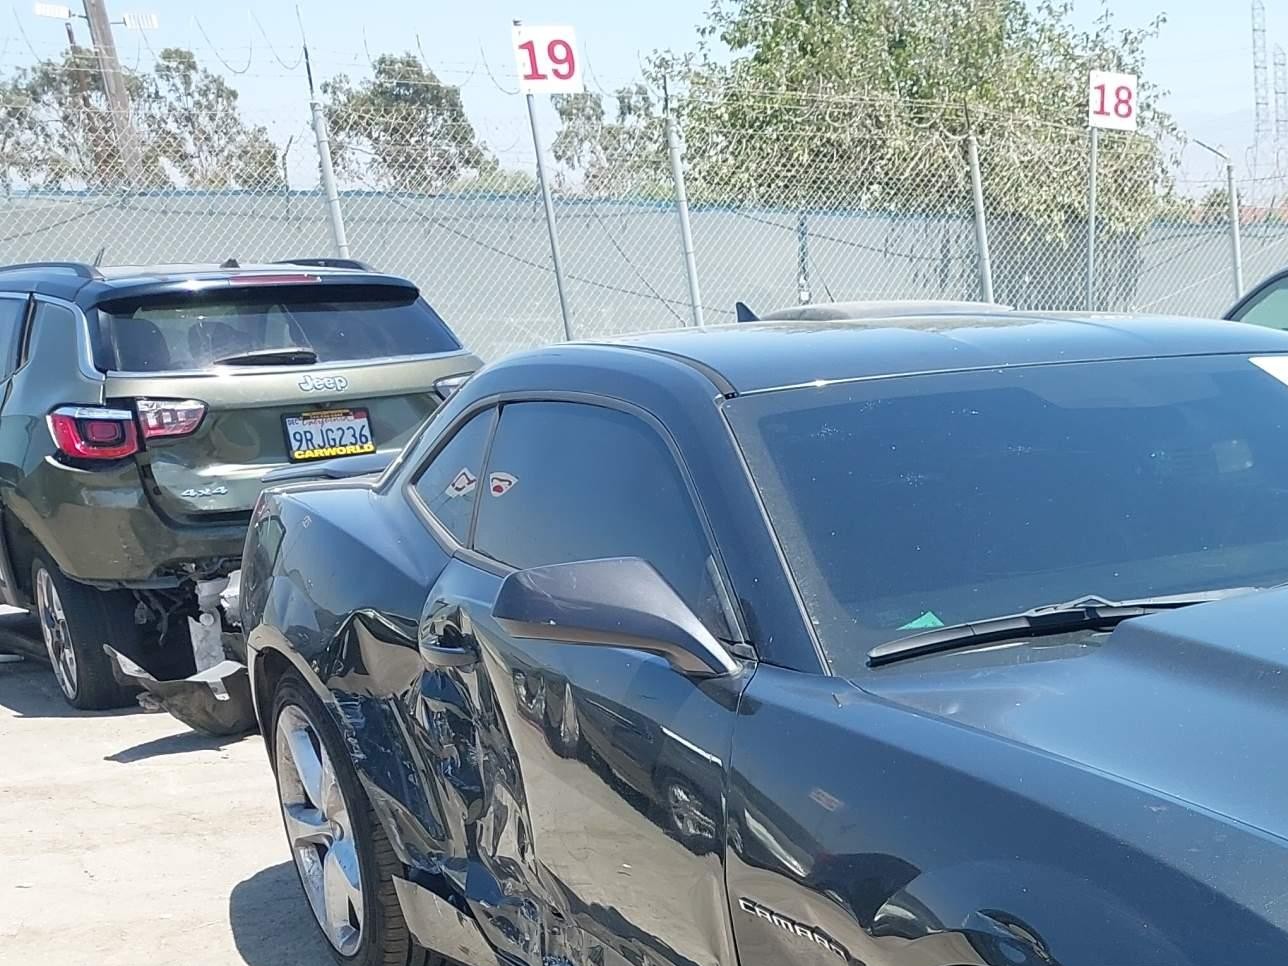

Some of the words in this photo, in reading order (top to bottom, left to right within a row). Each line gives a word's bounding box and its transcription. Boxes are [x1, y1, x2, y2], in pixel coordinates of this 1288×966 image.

[518, 39, 575, 80] 19
[1093, 84, 1132, 118] 18
[299, 374, 348, 392] Jeep
[292, 424, 369, 452] 9RJG236
[294, 442, 375, 459] CARWORLD
[181, 486, 228, 497] 4x4
[739, 897, 849, 961] CAMARO
